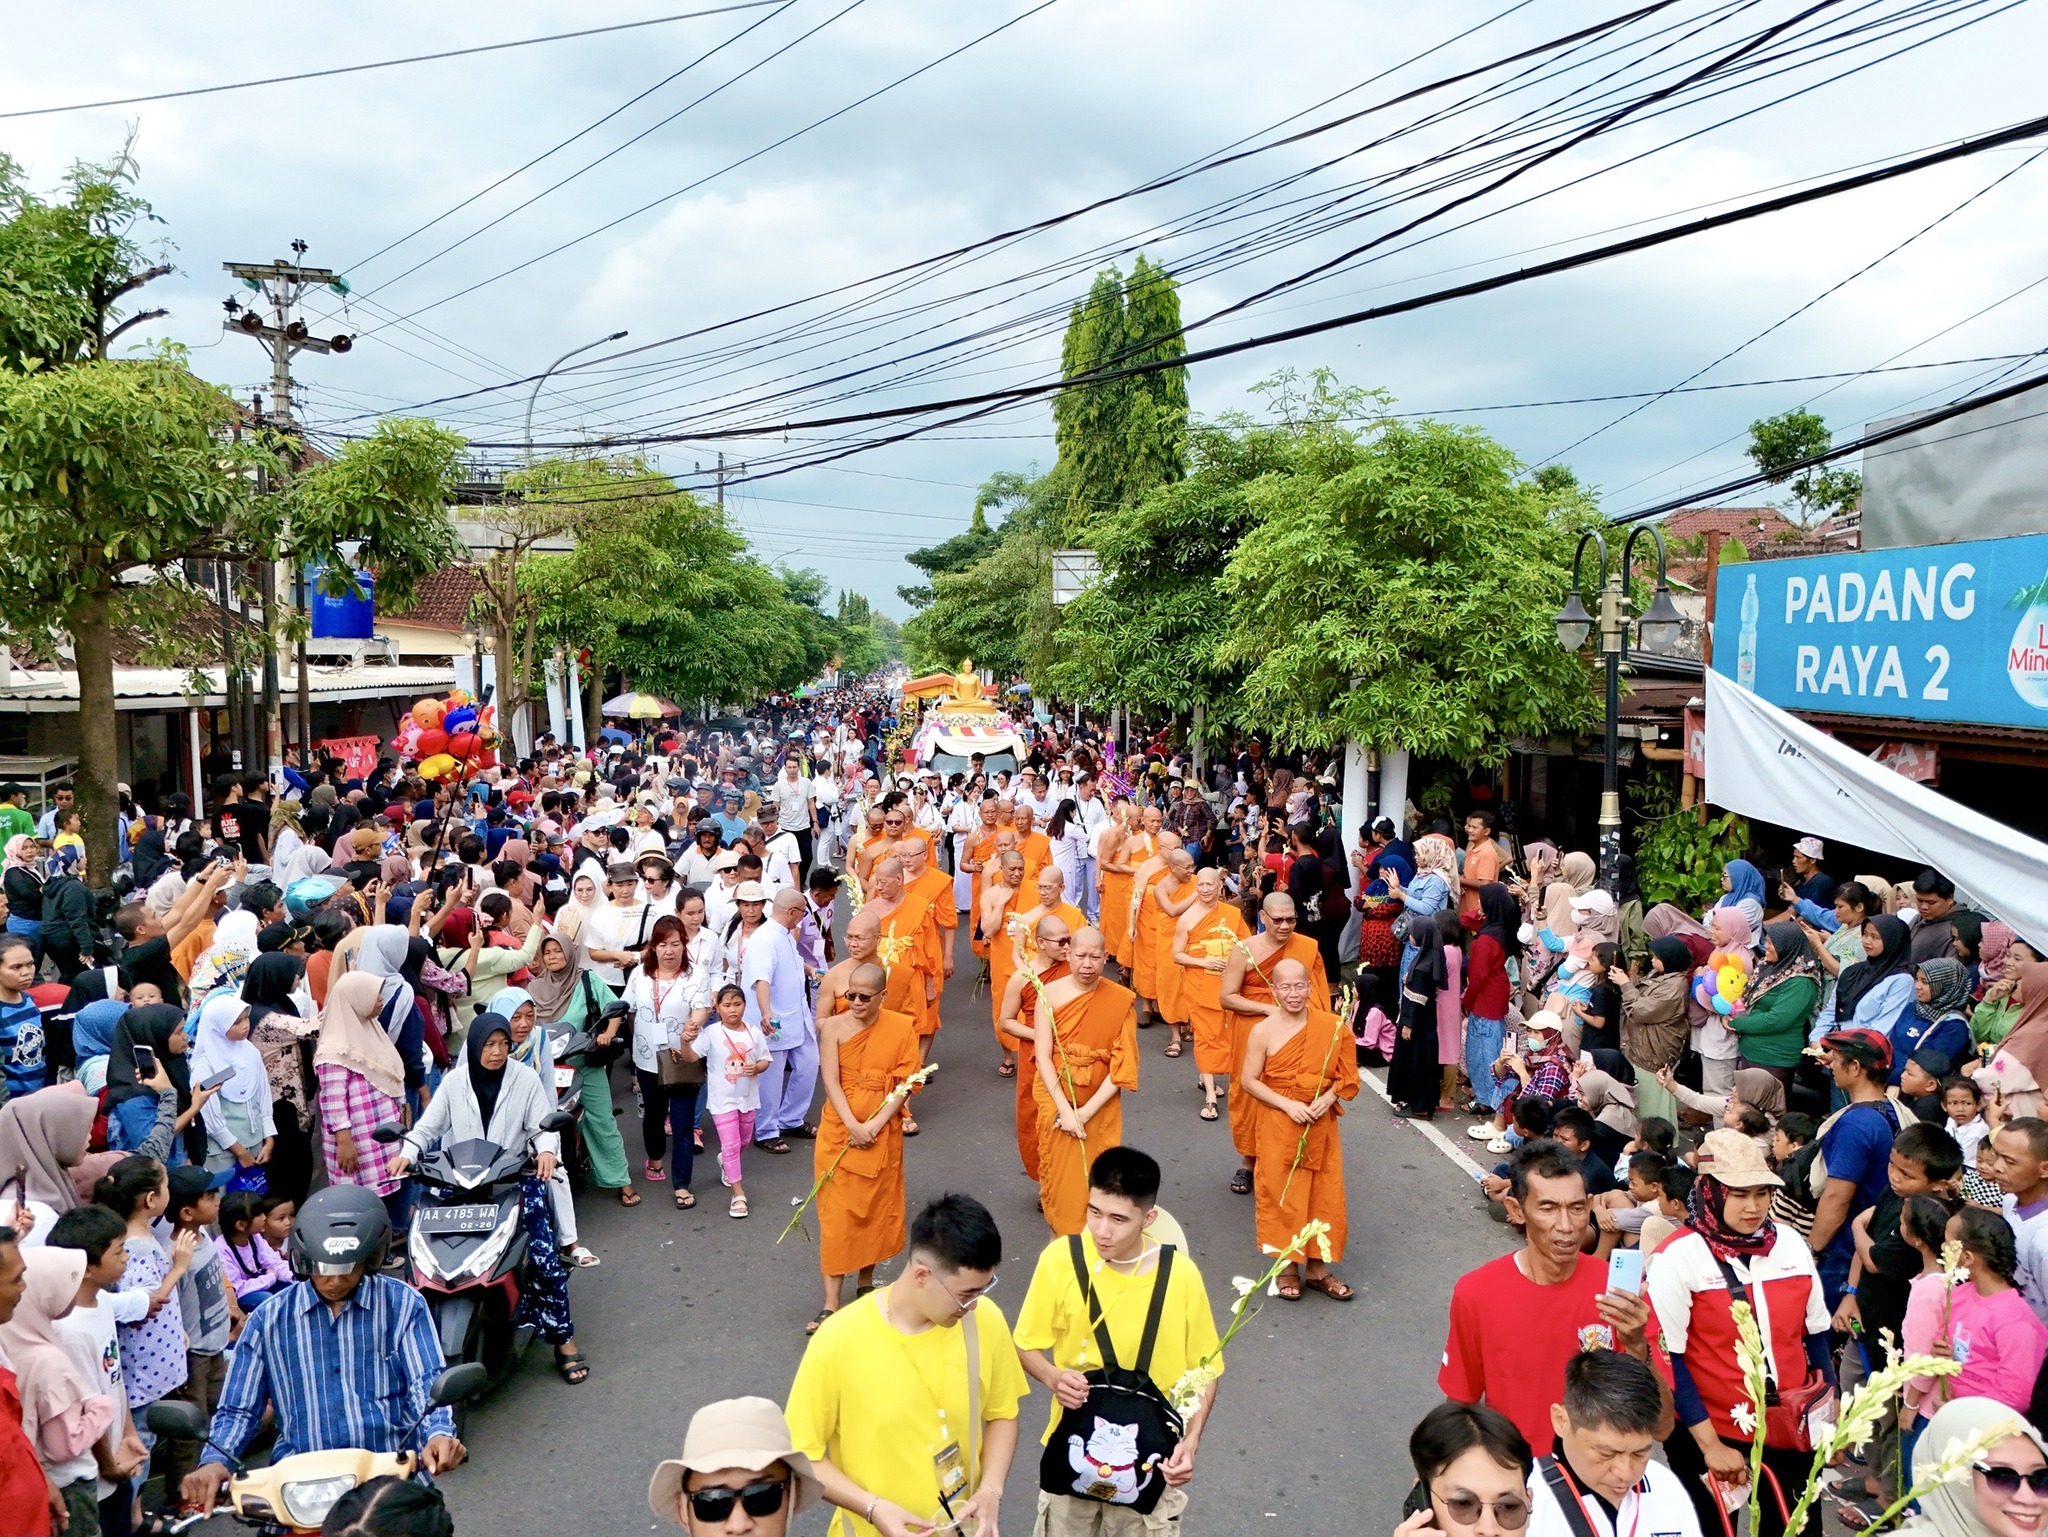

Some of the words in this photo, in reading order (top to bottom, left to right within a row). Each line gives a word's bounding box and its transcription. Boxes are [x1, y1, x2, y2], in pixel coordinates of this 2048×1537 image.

[1785, 562, 1976, 624] PADANG
[2039, 624, 2048, 649] L
[1796, 645, 1908, 699] RAYA
[1922, 644, 1950, 701] 2
[424, 1210, 439, 1221] AA
[445, 1208, 474, 1219] 4185
[480, 1207, 495, 1218] WA
